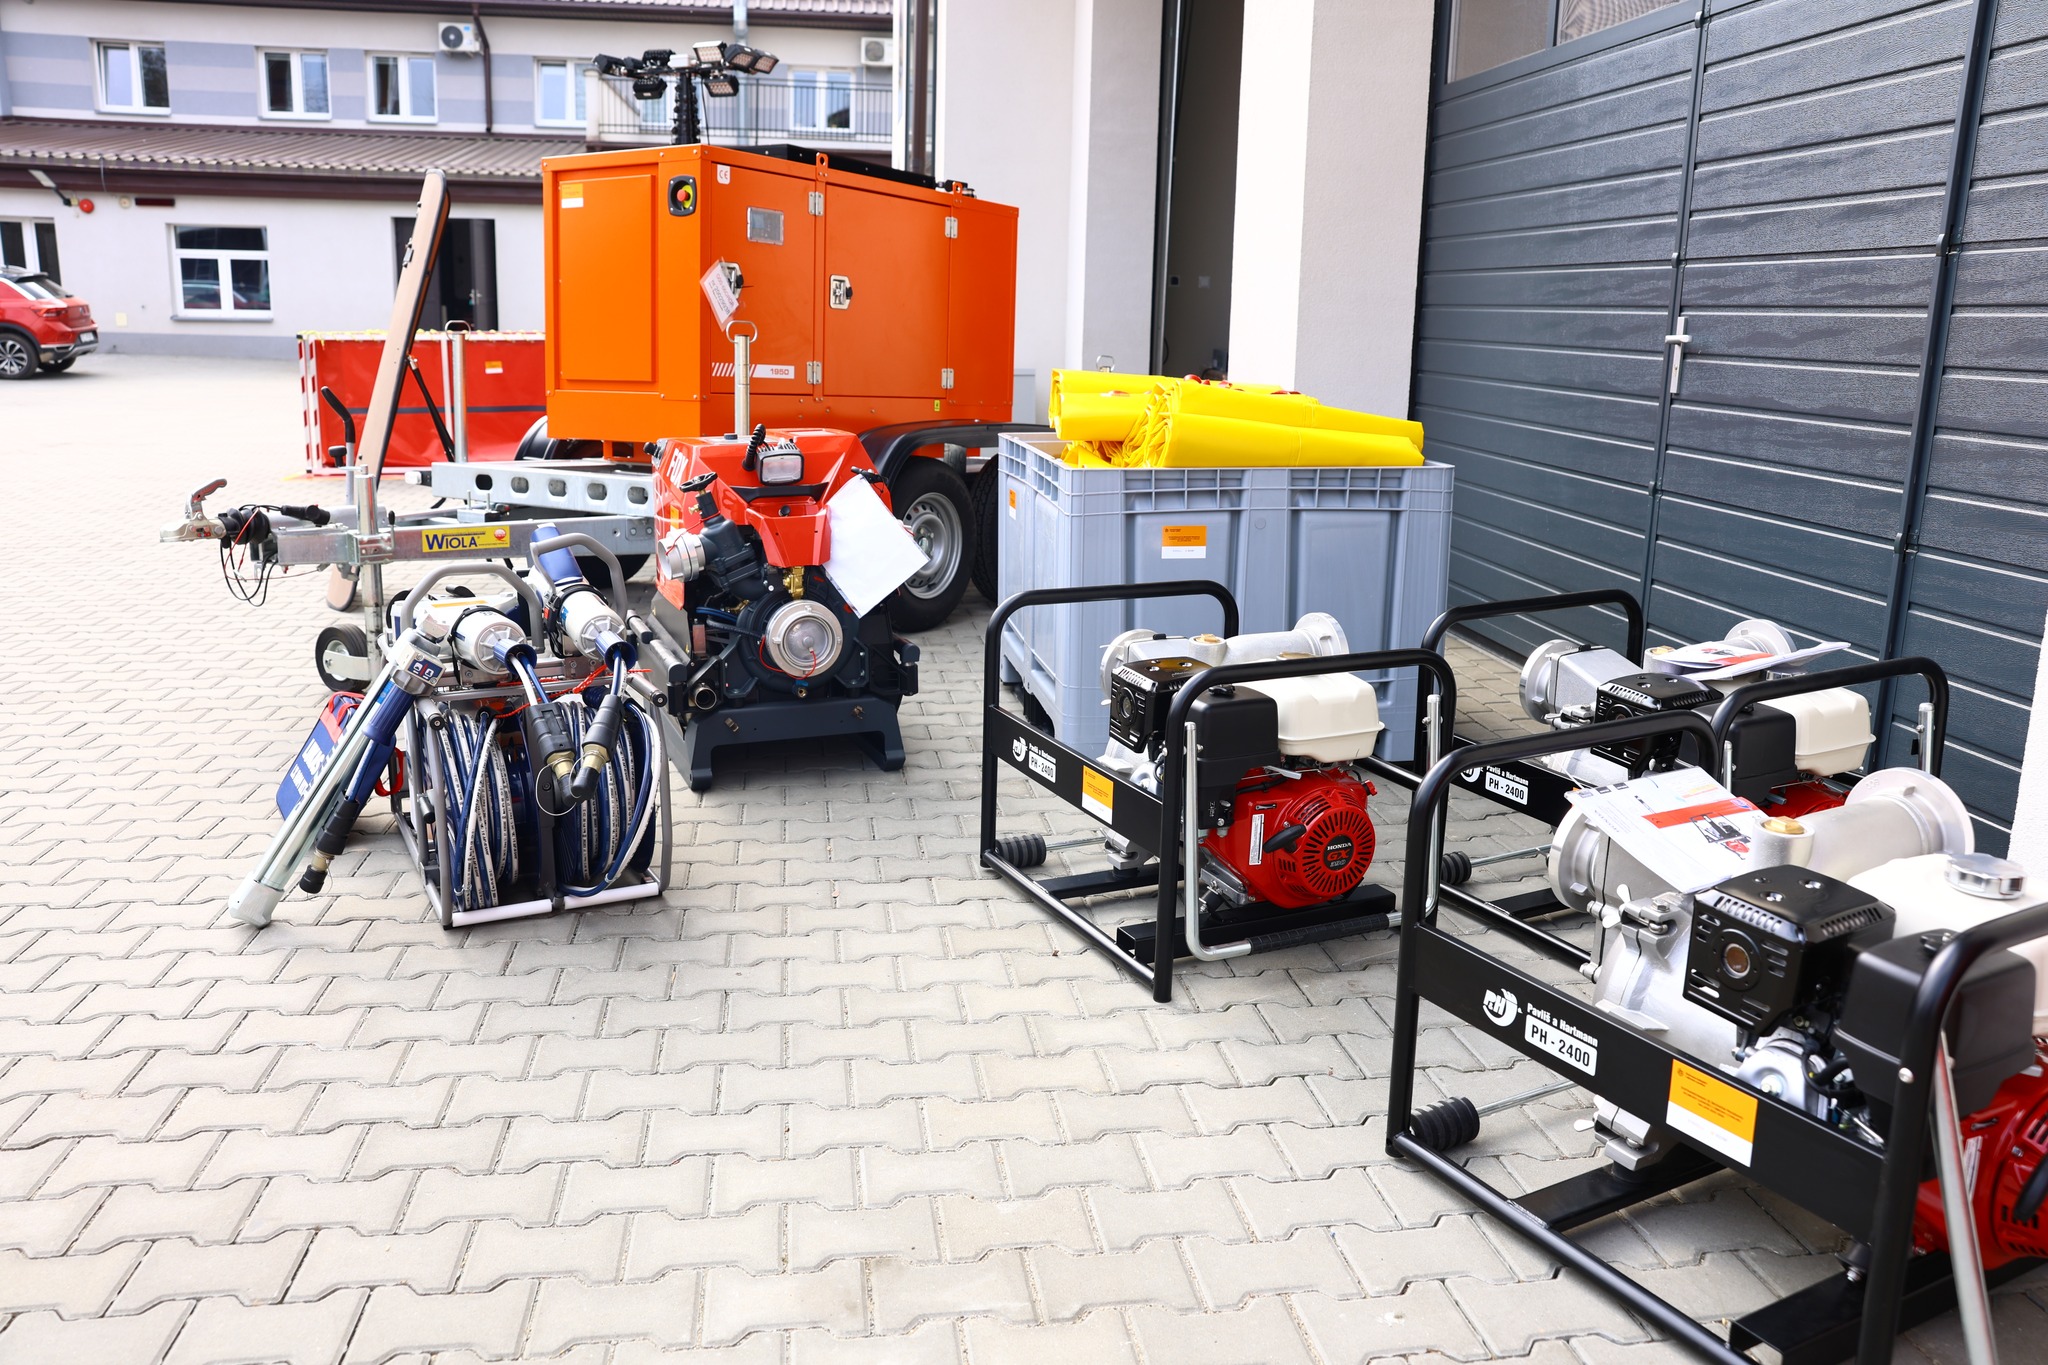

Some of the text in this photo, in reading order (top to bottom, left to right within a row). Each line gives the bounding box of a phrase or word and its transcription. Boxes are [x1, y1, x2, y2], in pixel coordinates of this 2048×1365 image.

[769, 367, 790, 376] 1950
[666, 447, 689, 489] FOX
[1488, 777, 1500, 790] PH
[1505, 784, 1525, 800] 2400
[1327, 842, 1352, 851] HONDA
[1327, 849, 1350, 861] GX
[1527, 1002, 1599, 1048] Pavliš a Hartmann
[1531, 1023, 1548, 1045] PH
[1558, 1039, 1590, 1067] 2400
